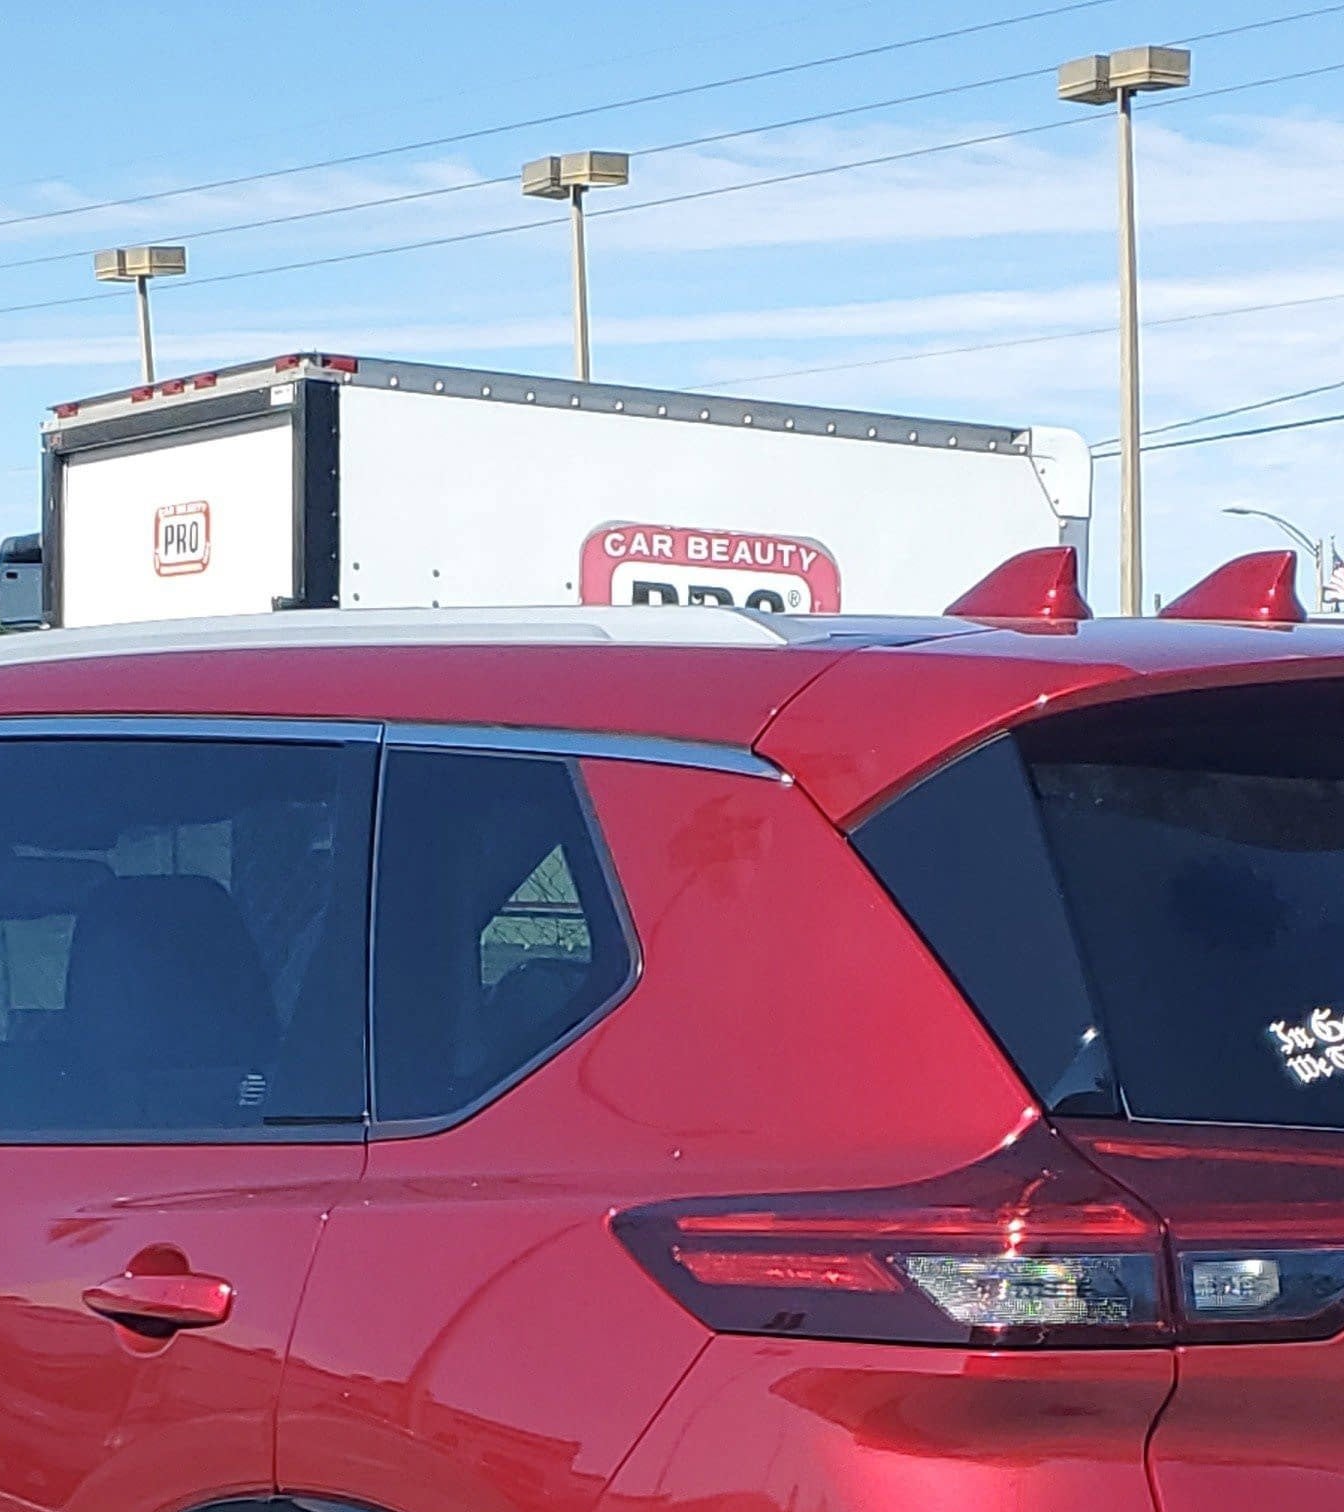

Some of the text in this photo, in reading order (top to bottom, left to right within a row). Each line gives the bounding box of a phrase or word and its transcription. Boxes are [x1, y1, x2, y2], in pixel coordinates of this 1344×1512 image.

[163, 520, 199, 556] PRO
[603, 531, 819, 573] CAR BEAUTY
[1268, 1020, 1316, 1055] In
[1286, 1052, 1335, 1083] We
